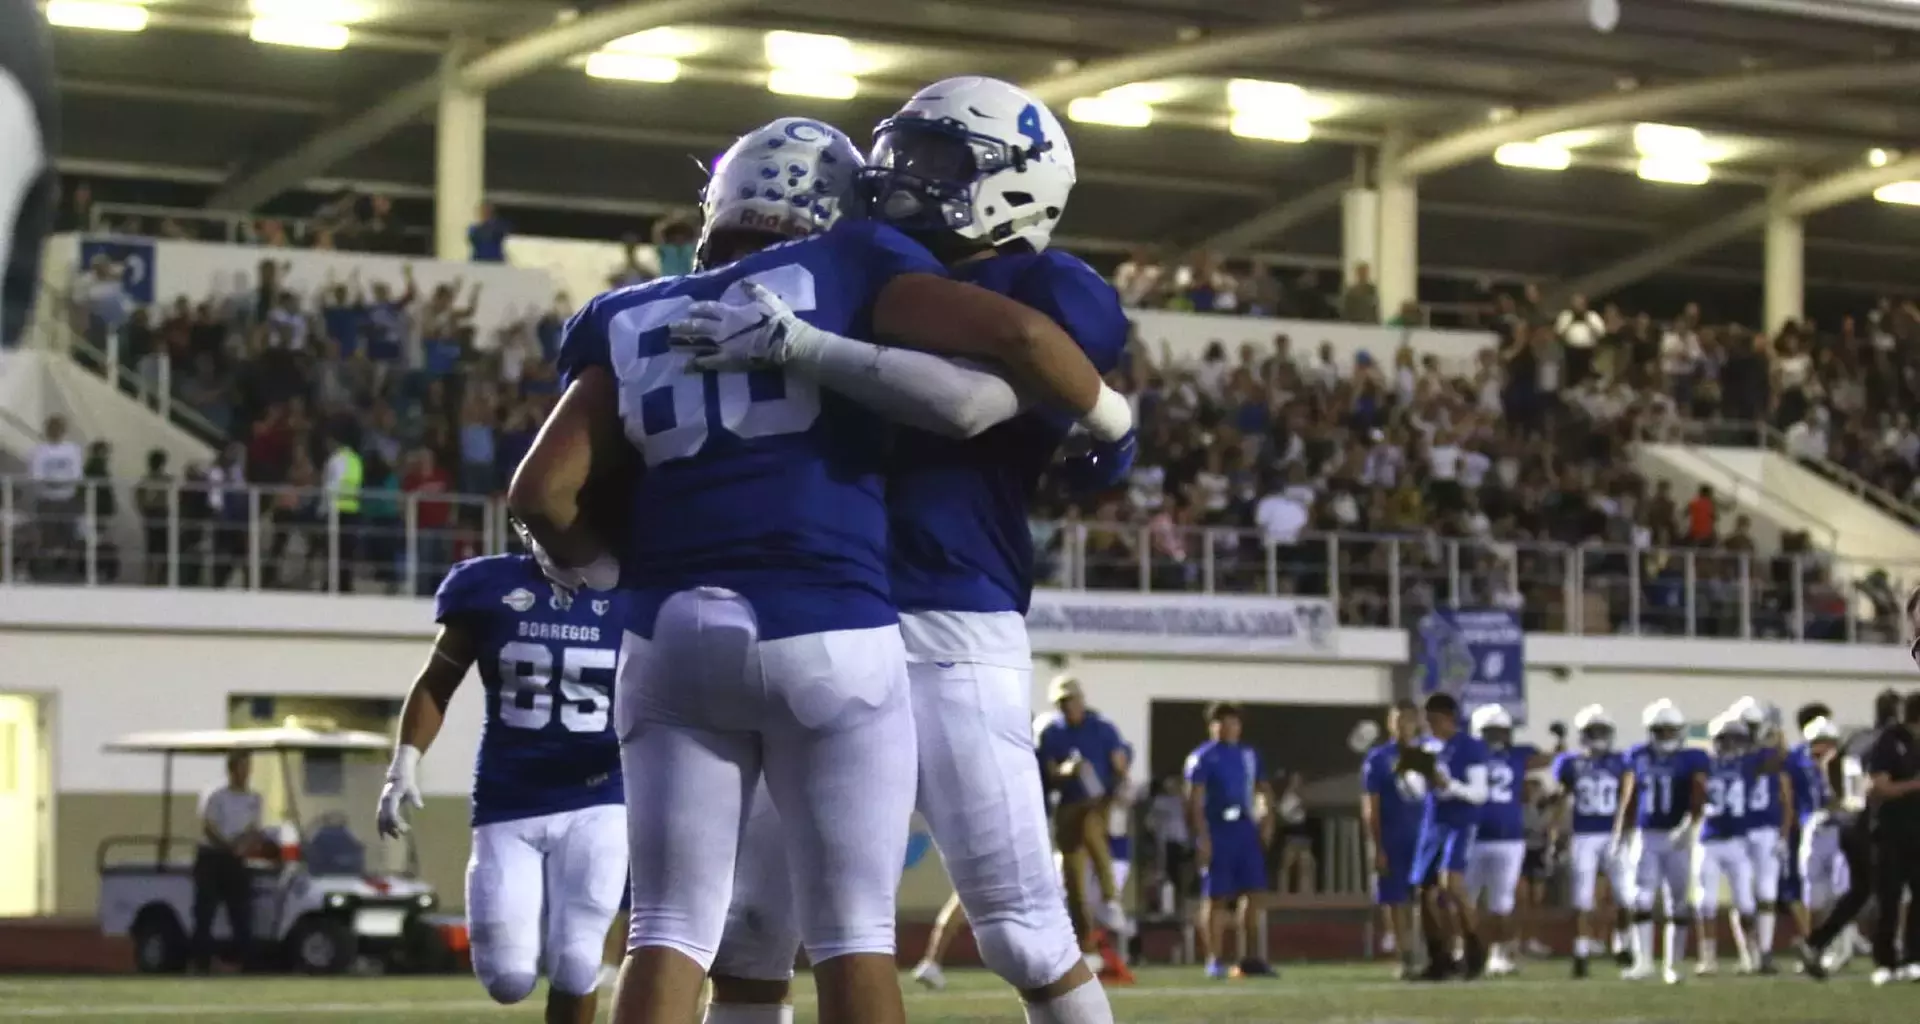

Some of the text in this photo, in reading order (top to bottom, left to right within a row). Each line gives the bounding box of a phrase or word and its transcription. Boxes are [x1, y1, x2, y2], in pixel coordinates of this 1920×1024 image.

[1017, 104, 1045, 149] 4
[608, 263, 821, 467] 86
[518, 621, 601, 641] BORREGOS
[499, 641, 616, 733] 85
[1576, 775, 1619, 816] 30
[1706, 776, 1746, 817] 34
